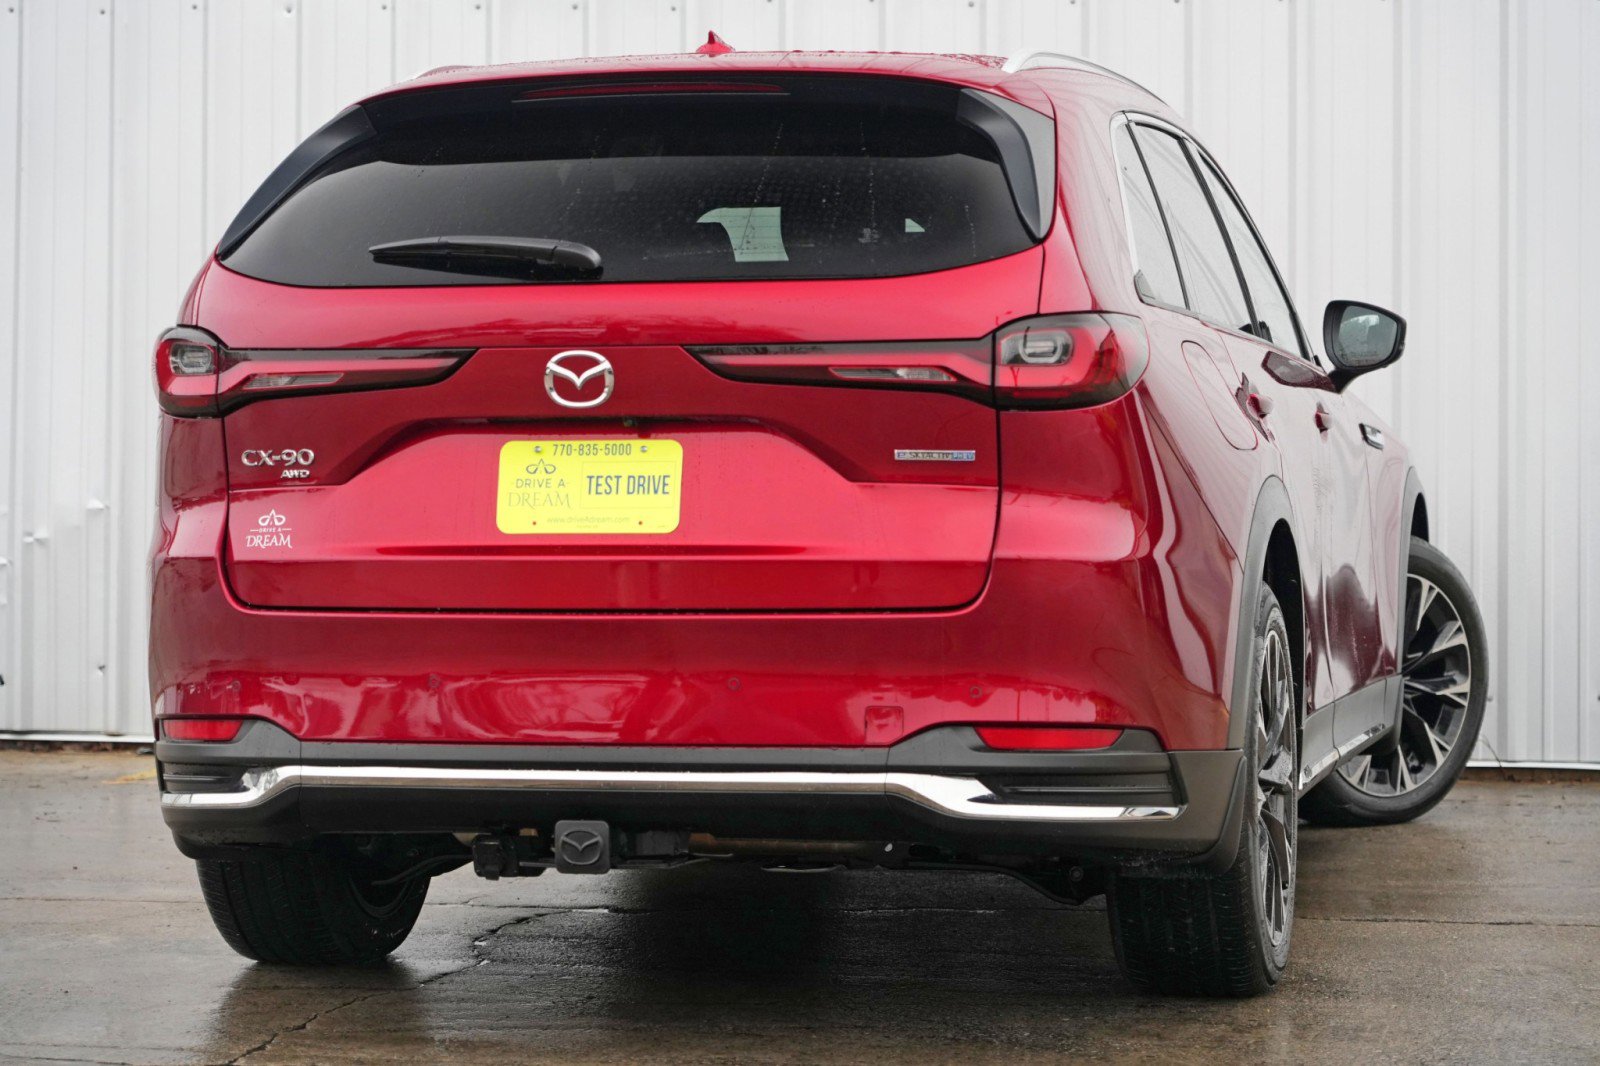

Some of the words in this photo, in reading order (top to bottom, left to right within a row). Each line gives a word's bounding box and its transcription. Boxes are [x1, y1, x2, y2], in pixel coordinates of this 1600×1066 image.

[241, 448, 315, 466] CX-90
[552, 443, 632, 456] 770-835-5000
[280, 469, 310, 478] AWD
[515, 478, 552, 488] DRIVE
[557, 478, 566, 488] A
[586, 475, 622, 495] TEST
[626, 474, 671, 495] DRIVE
[507, 491, 571, 509] DREAM
[245, 533, 293, 548] DREAM
